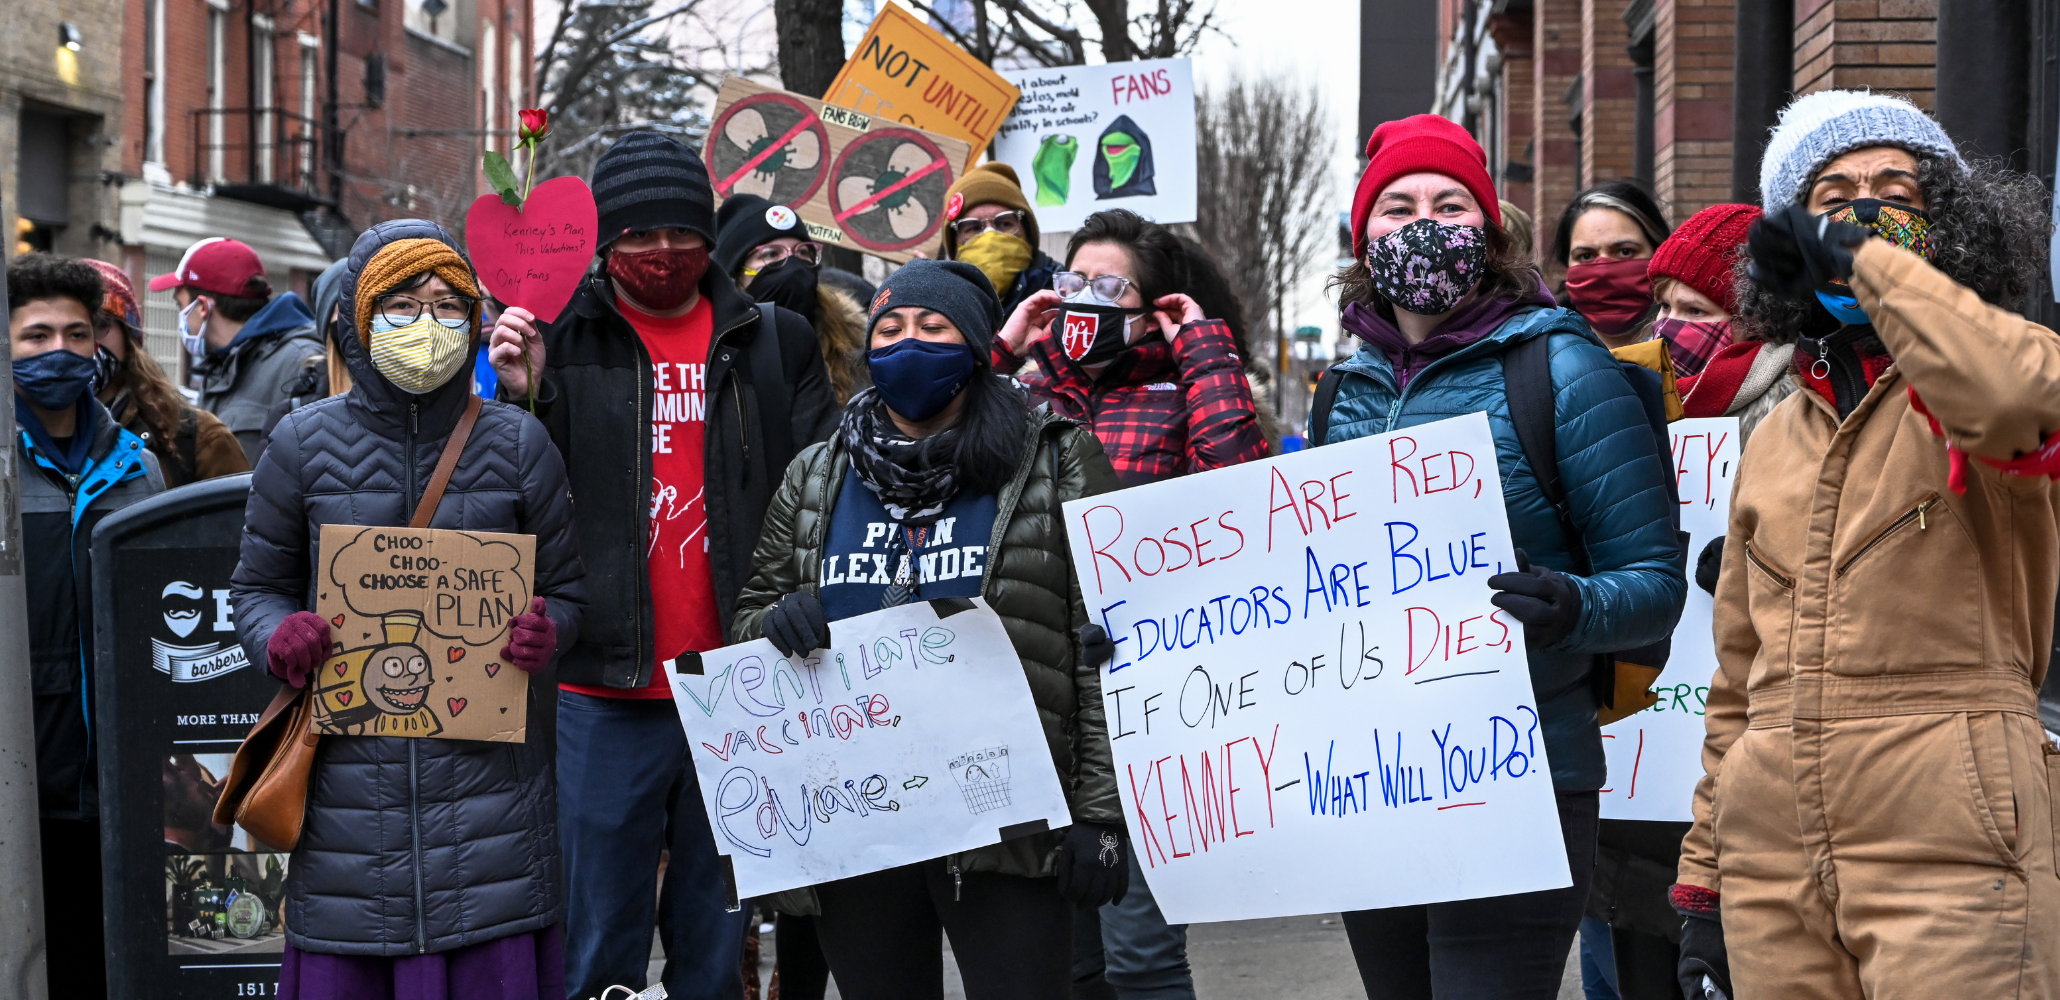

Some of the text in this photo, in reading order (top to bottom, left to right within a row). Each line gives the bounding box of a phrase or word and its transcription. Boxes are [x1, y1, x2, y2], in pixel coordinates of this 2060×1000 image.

[862, 34, 989, 142] NOT UNTIL
[1030, 74, 1067, 89] about
[1112, 68, 1171, 105] FANS
[823, 106, 847, 125] FANS
[1061, 102, 1075, 113] air
[1043, 118, 1052, 128] in
[1056, 111, 1098, 127] schools?
[503, 222, 584, 242] Kenney's Plan
[515, 240, 585, 255] This Valentines?
[496, 268, 550, 294] Only Fans
[1082, 436, 1483, 595] ROSES ARE RED,
[373, 533, 434, 553] CHOO-
[389, 554, 448, 571] CHOO-
[819, 545, 990, 588] LEXANDE
[359, 567, 505, 593] CHOOSE A SAFE
[1101, 521, 1503, 673] EDUCATORS ARE BLUE,
[436, 593, 514, 629] PLAN
[1107, 606, 1512, 740] IF ONE OF US DIES,
[177, 713, 259, 726] MORE THAN
[1374, 728, 1433, 808] WILL
[1431, 722, 1487, 799] YOU
[1489, 705, 1538, 780] DO?
[237, 982, 266, 997] 151
